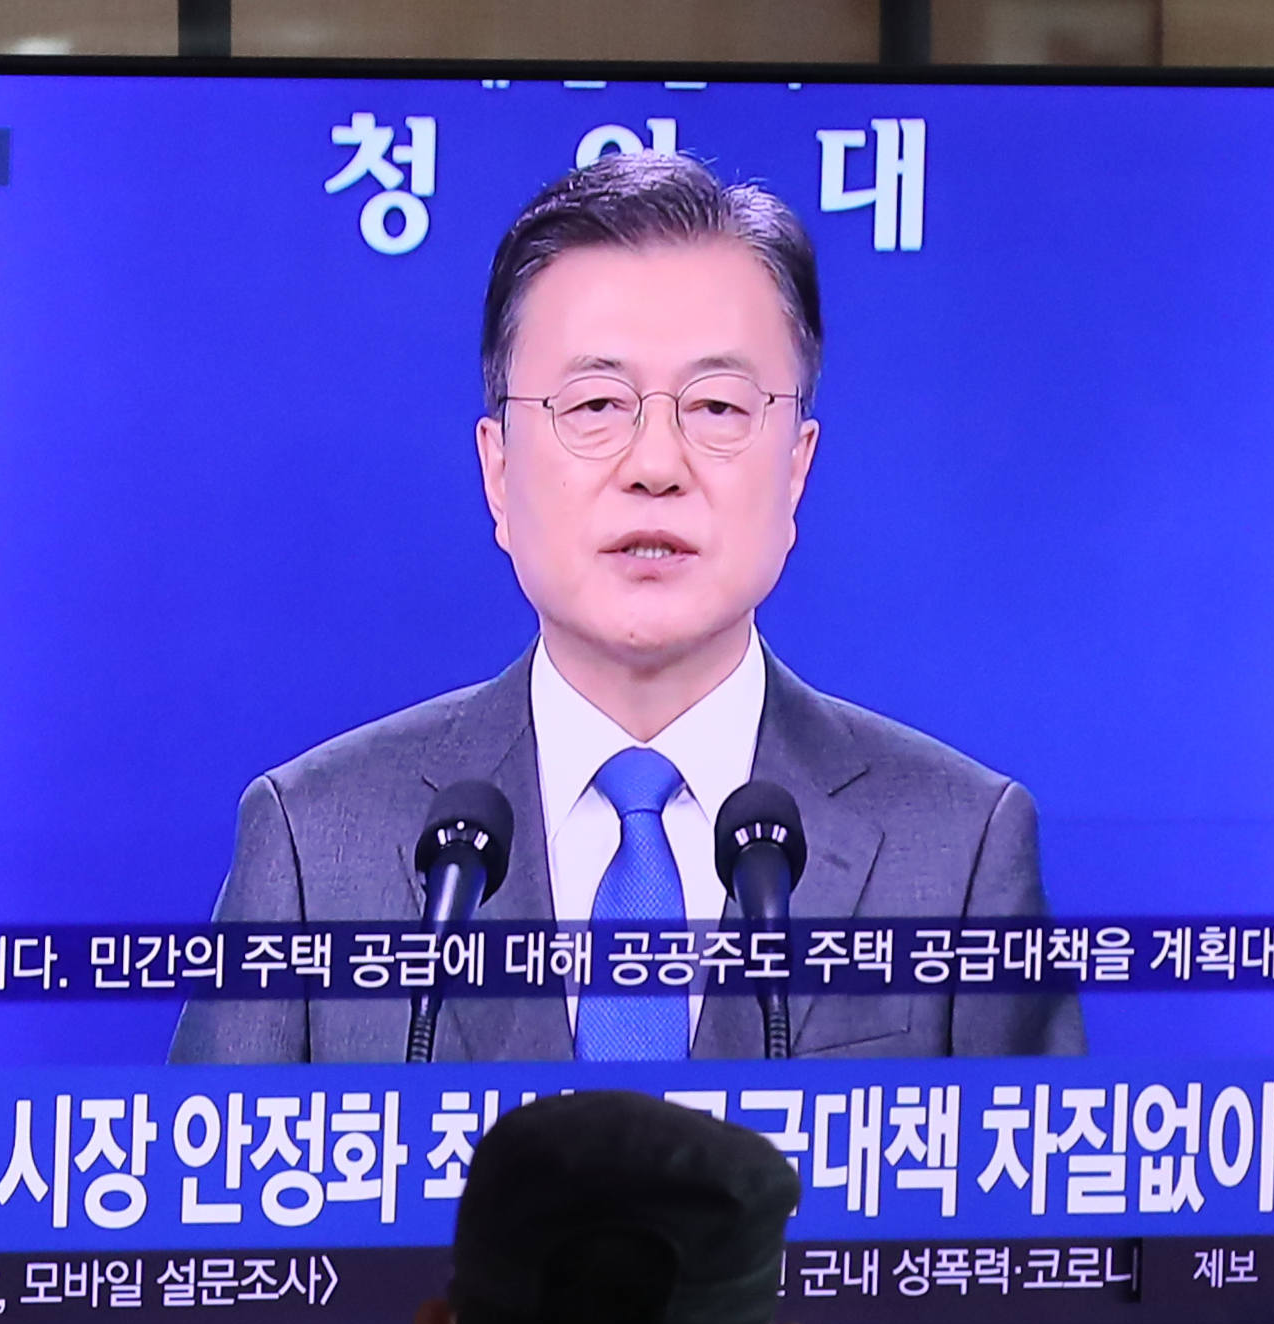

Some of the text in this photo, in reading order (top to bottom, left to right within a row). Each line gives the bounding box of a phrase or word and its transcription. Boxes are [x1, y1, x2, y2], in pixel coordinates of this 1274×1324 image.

[90, 933, 225, 989] 민간의
[241, 932, 332, 989] 주택
[348, 931, 485, 989] 공급에
[505, 931, 592, 986] 대해
[608, 931, 790, 986] 공공주도
[804, 929, 893, 984] 주택
[909, 926, 1135, 983] 공급대책을
[173, 1089, 408, 1227] 안정화
[20, 1258, 142, 1308] 모바일
[800, 1248, 879, 1297] 군내
[1192, 1247, 1258, 1289] 제보
